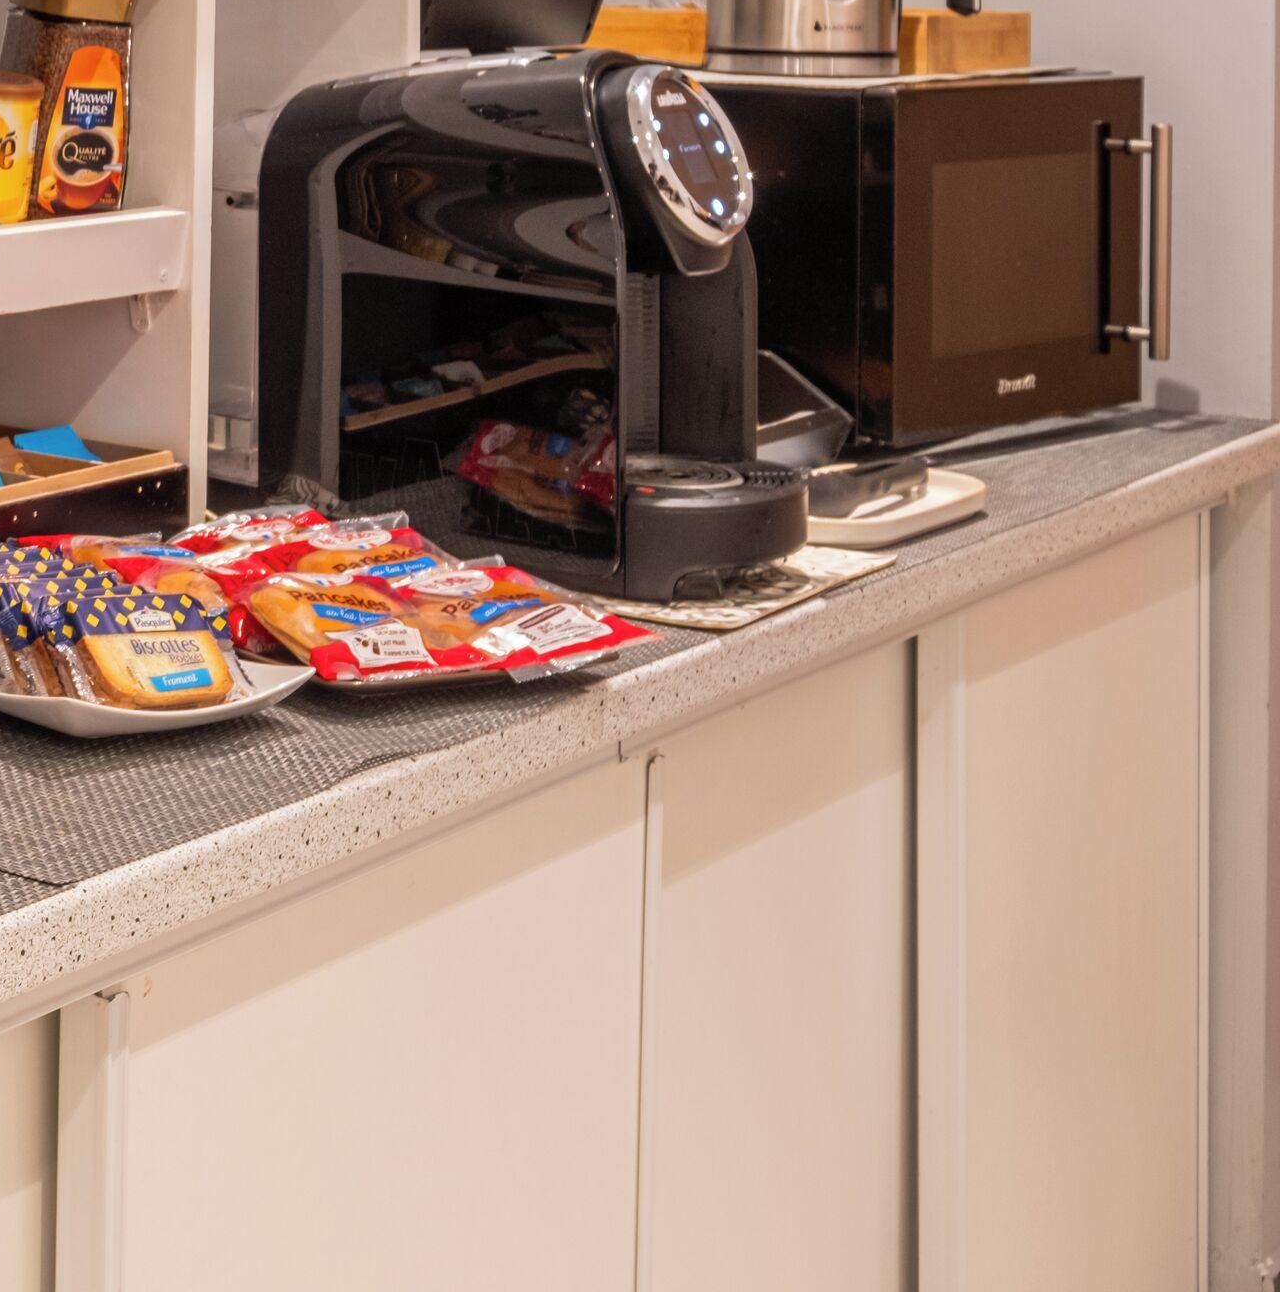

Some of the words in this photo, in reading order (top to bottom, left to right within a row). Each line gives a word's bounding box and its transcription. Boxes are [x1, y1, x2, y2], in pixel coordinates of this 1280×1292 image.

[67, 88, 114, 104] Maxwell
[70, 103, 108, 116] House
[287, 590, 391, 612] Pancakes
[134, 617, 172, 629] Pasquier
[130, 638, 200, 655] Biscottes
[162, 673, 198, 687] Froment
